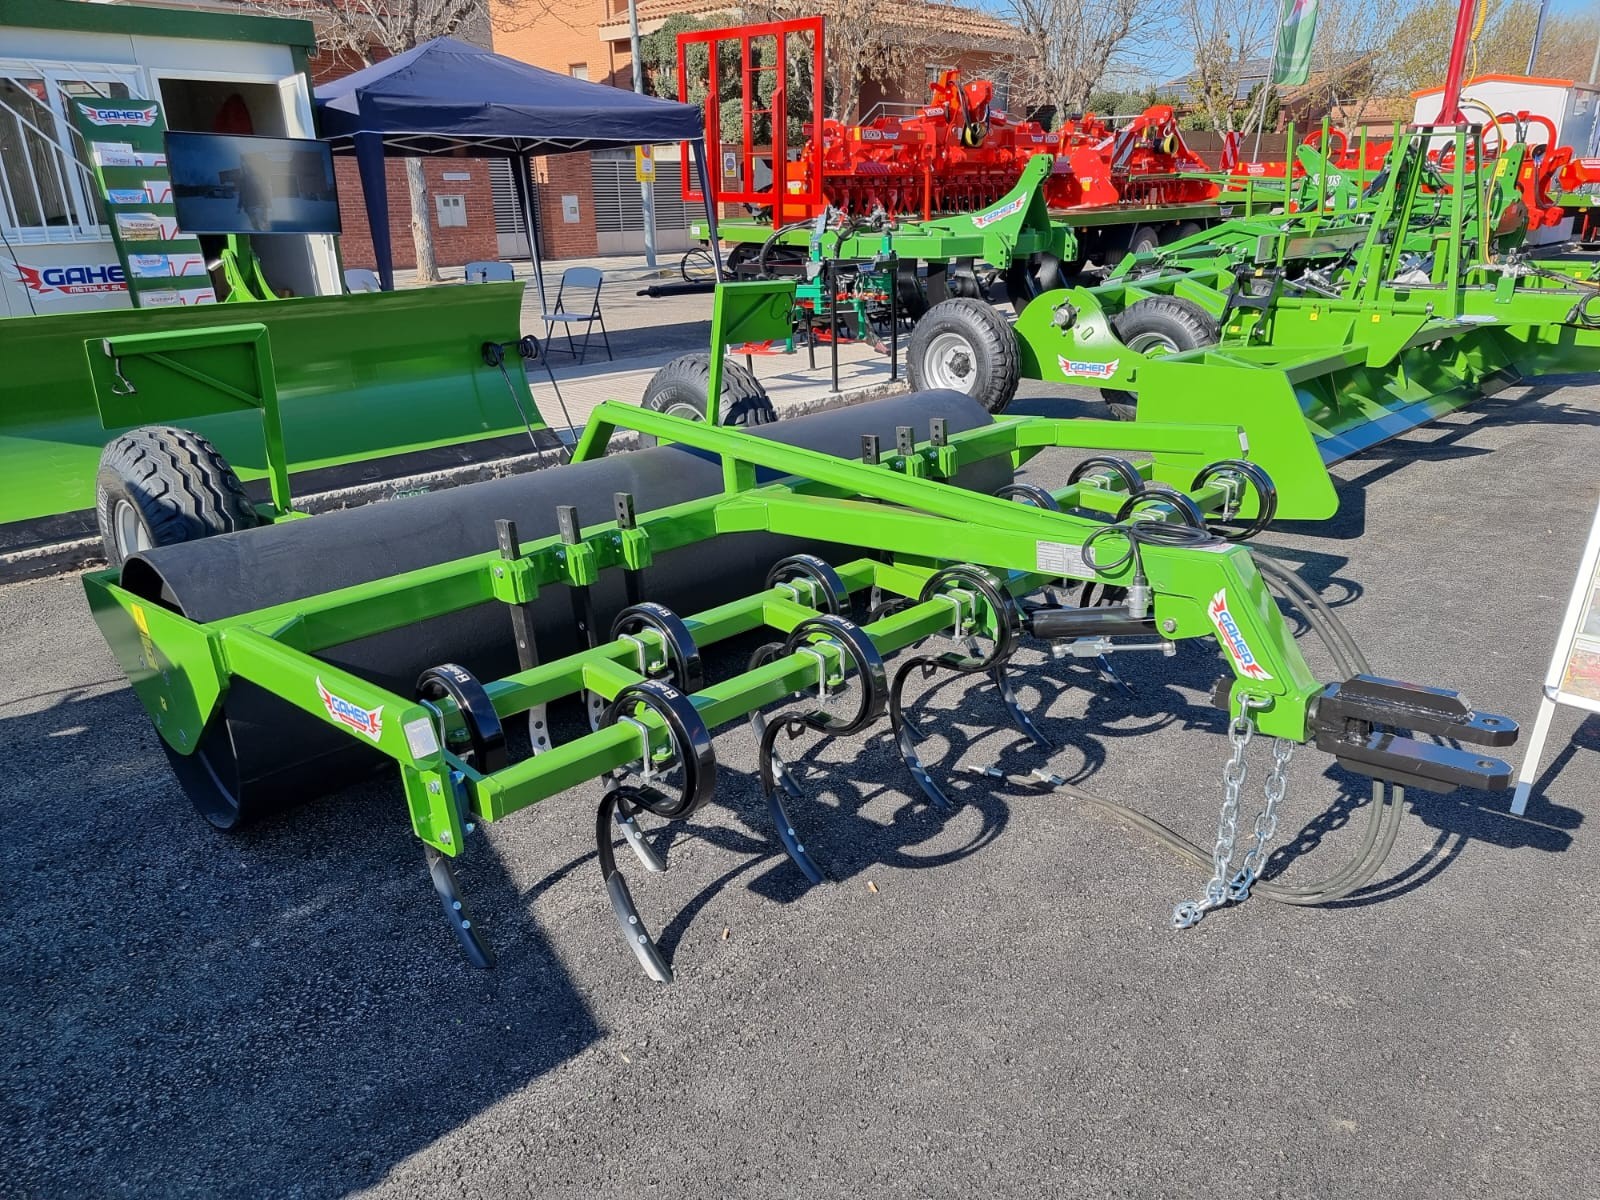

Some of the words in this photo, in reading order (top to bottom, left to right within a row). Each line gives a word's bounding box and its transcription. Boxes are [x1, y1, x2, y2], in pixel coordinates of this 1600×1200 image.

[97, 110, 144, 120] GAHER
[42, 265, 126, 286] GAHE
[1070, 362, 1106, 373] GAHER
[1219, 611, 1254, 665] GAHER
[331, 696, 370, 727] GAHER
